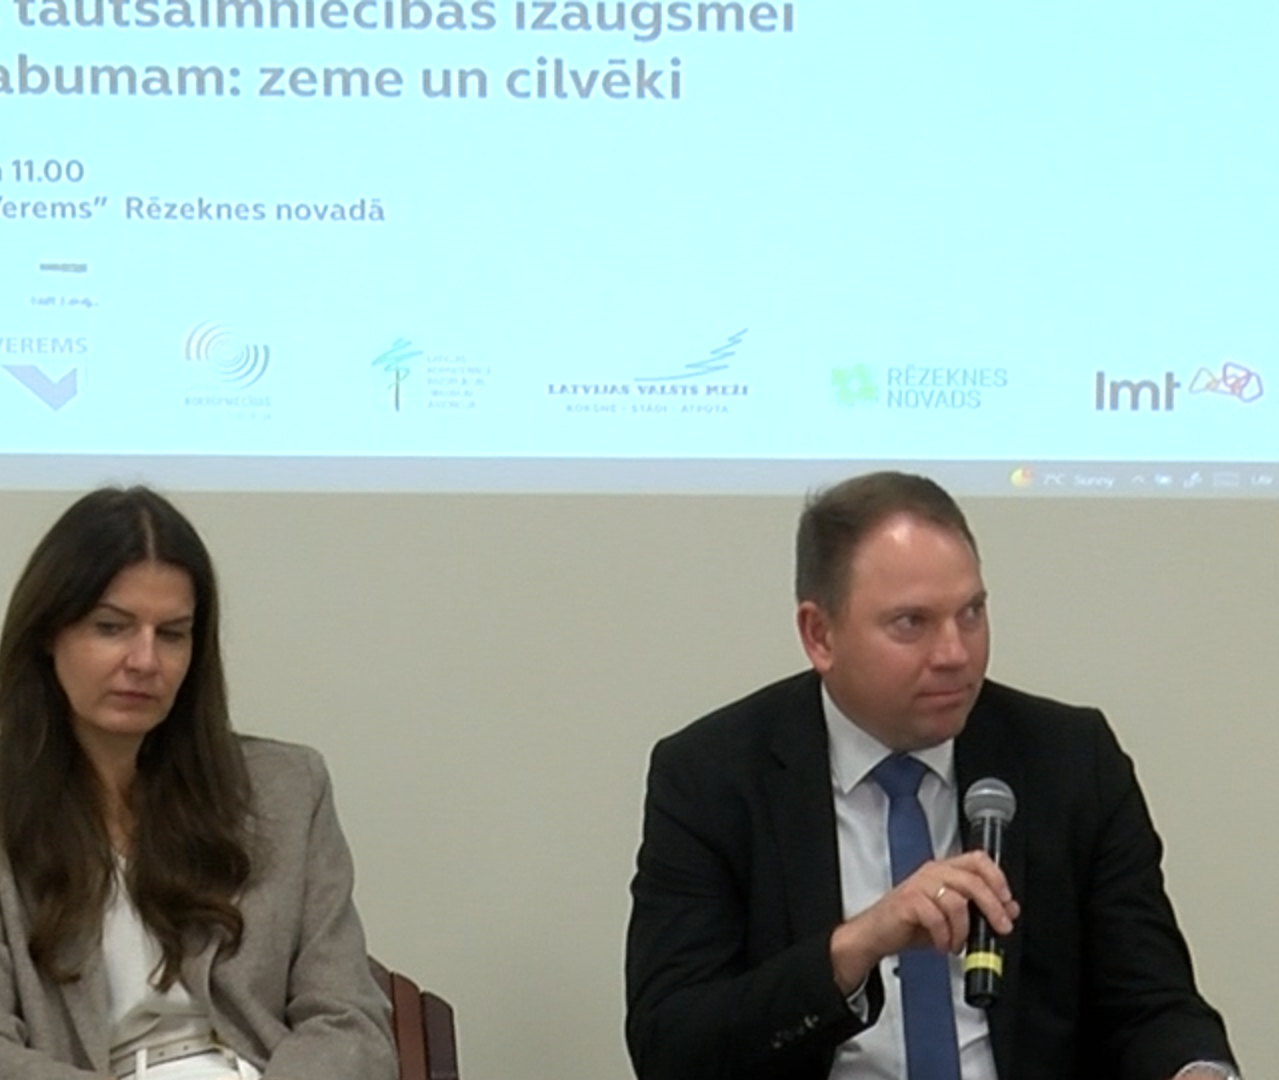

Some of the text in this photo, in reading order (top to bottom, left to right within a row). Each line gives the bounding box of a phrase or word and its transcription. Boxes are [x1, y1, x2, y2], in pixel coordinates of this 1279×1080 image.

[258, 66, 404, 98] zeme
[421, 67, 488, 99] un
[505, 55, 682, 100] cilvēki
[11, 159, 85, 183] 11.00
[125, 196, 267, 221] Rēzeknes
[276, 197, 385, 222] novadā
[887, 364, 1008, 388] RĒZEKNES
[887, 389, 982, 408] NOVADS
